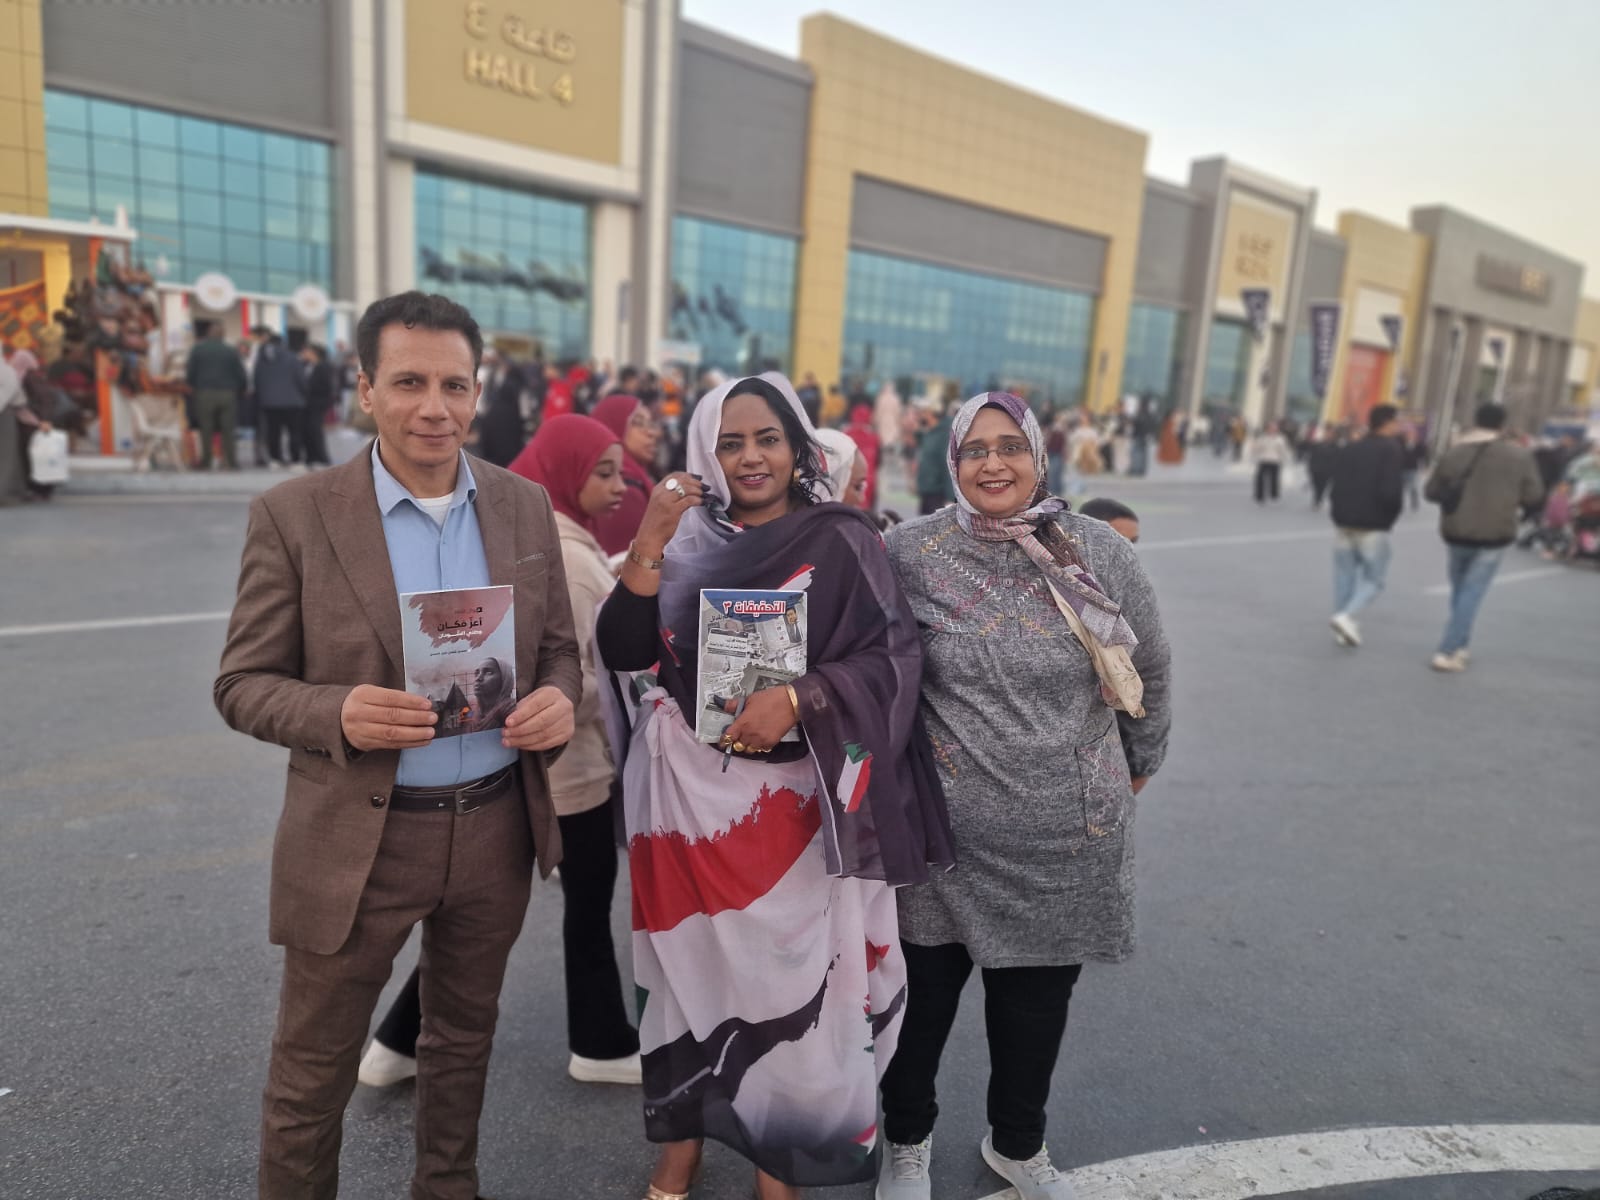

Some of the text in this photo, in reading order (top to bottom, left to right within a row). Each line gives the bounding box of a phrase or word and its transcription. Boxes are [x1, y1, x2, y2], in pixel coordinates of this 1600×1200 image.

[500, 13, 576, 64] قاعة
[463, 48, 575, 107] HALL 4
[734, 601, 786, 617] التحقيقات
[437, 620, 467, 632] مكان
